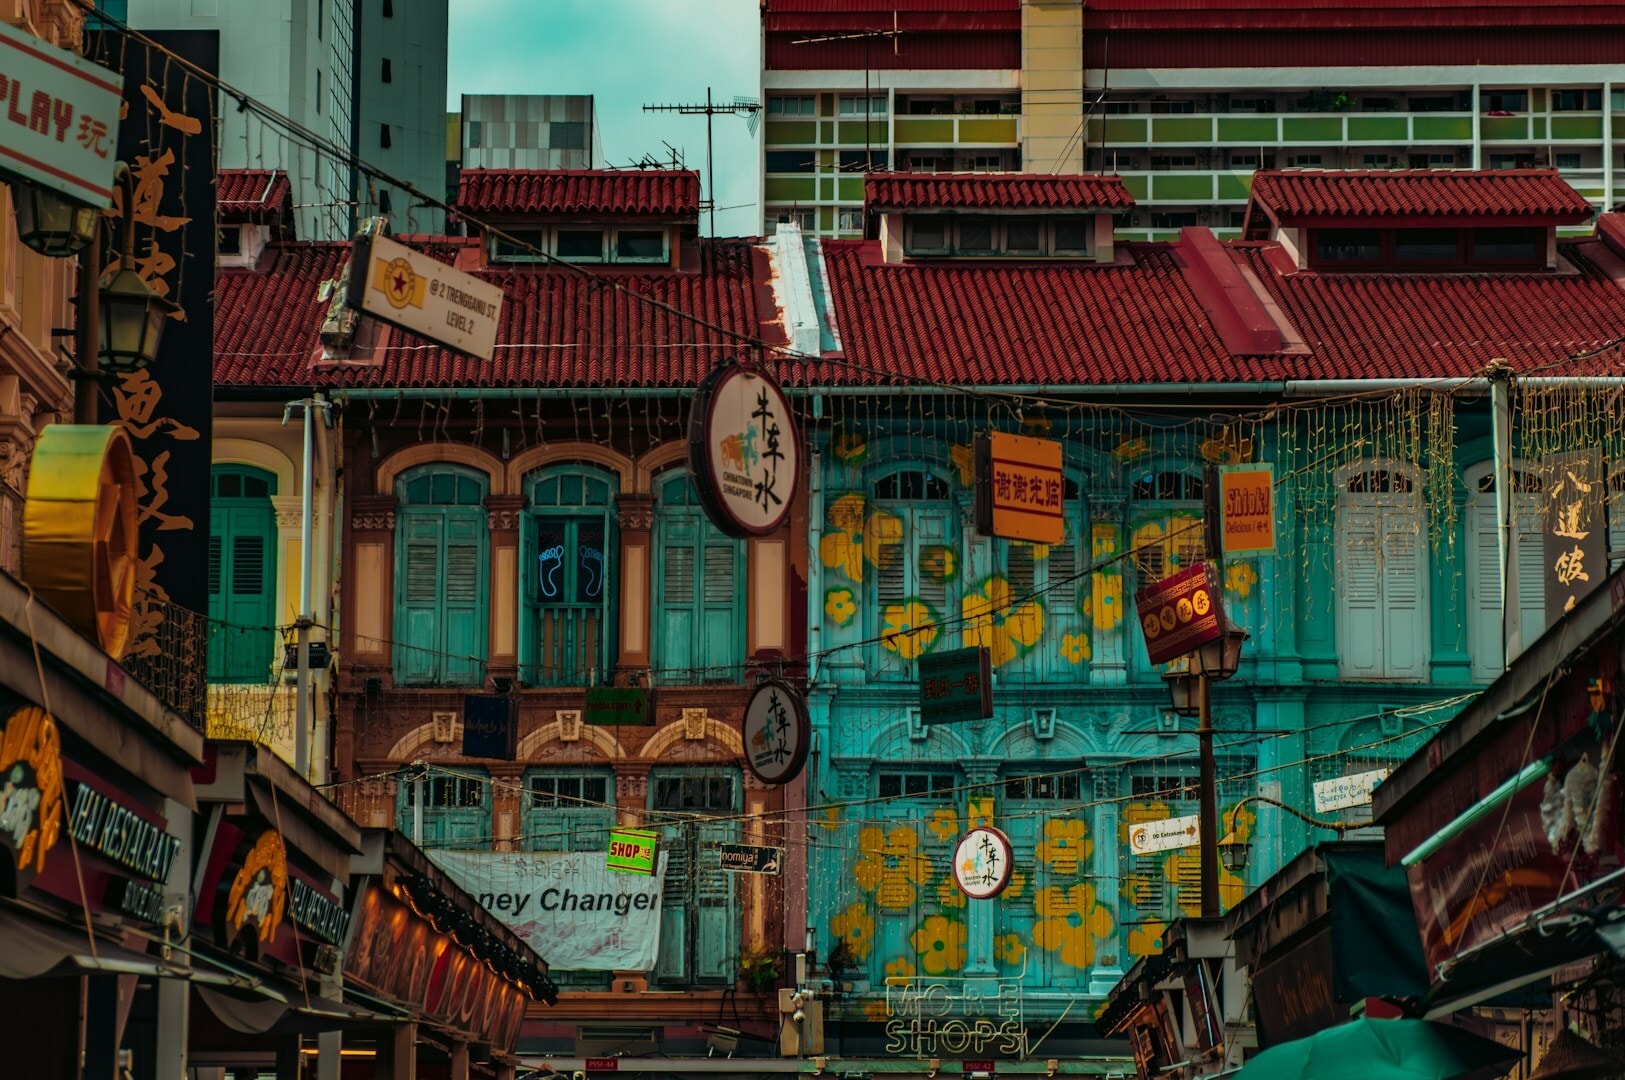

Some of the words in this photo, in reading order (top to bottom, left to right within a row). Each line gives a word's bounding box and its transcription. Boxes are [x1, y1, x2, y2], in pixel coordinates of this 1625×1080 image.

[77, 114, 108, 159] 玩
[438, 283, 445, 298] 2
[446, 285, 486, 315] TRENGGANU
[446, 310, 466, 332] LEVEL
[467, 319, 474, 335] 2
[751, 385, 785, 515] 牛车水
[722, 471, 753, 489] CHINATOWN
[722, 483, 753, 501] SINGAPORE
[995, 471, 1060, 508] 谢谢光临
[1226, 486, 1270, 518] Shiok!
[768, 688, 792, 766] 牛车水
[69, 782, 108, 847] THAI
[97, 800, 181, 885] RESTAURANT
[610, 842, 640, 858] SHOP
[721, 852, 753, 864] nomiya
[979, 833, 999, 888] 牛车水
[479, 892, 532, 917] ney
[886, 984, 1019, 1017] MORE
[886, 1019, 1022, 1055] SHOPS
